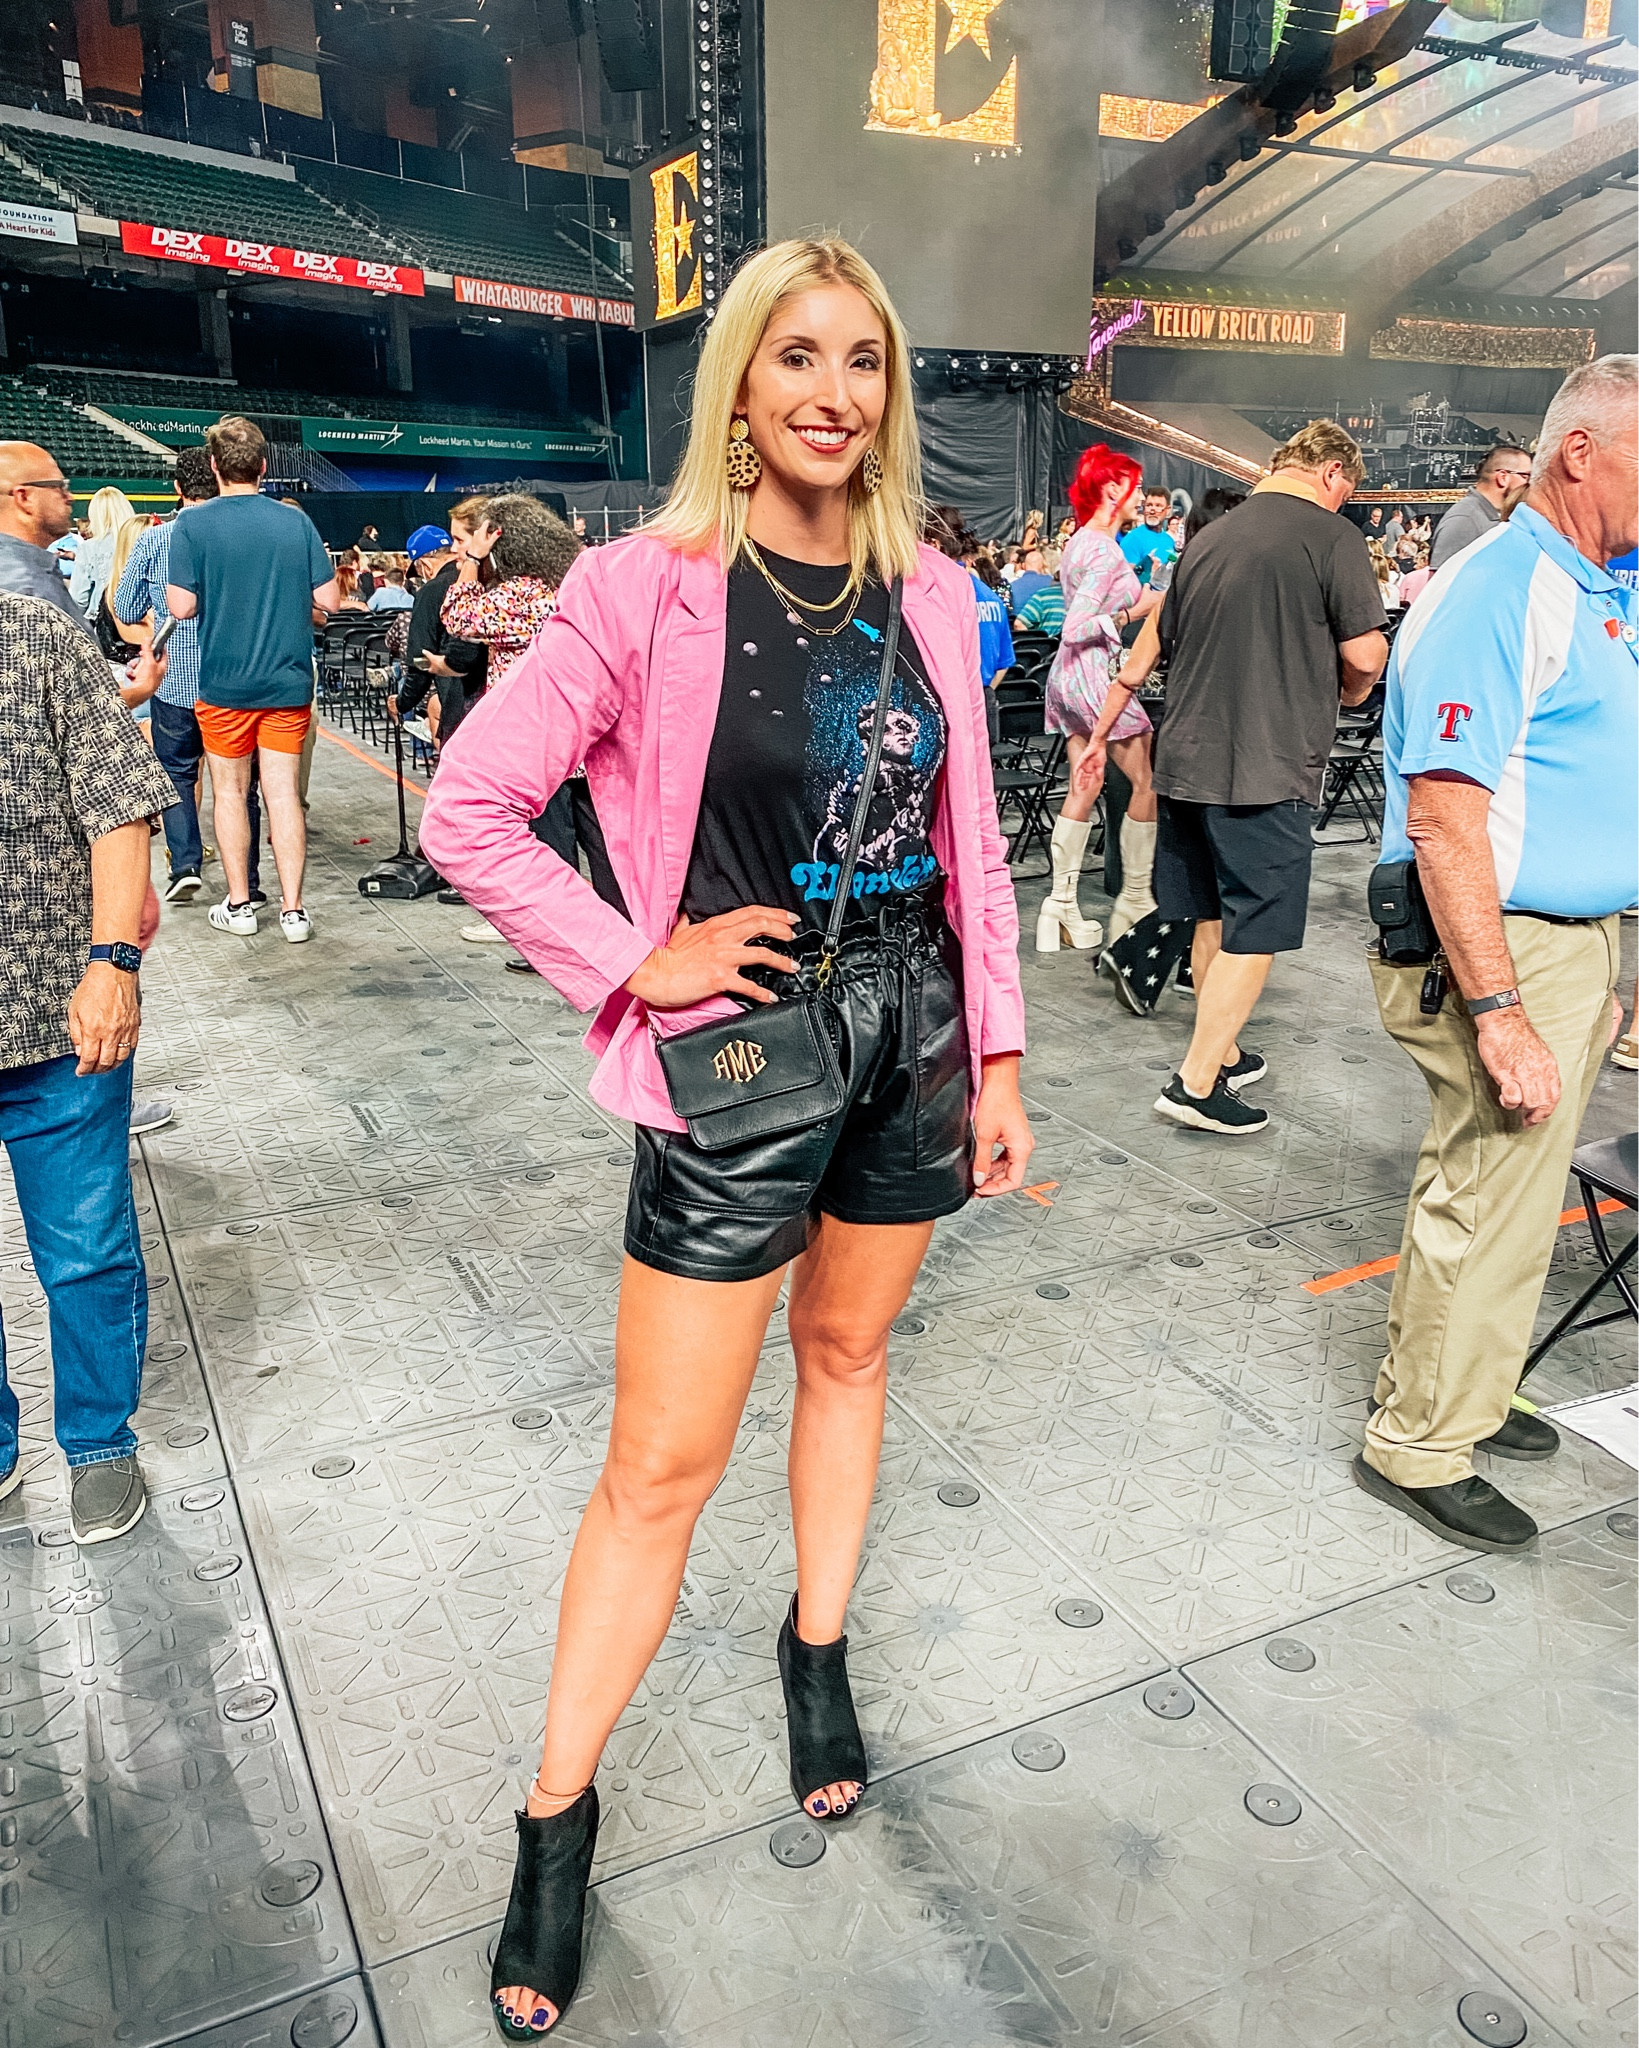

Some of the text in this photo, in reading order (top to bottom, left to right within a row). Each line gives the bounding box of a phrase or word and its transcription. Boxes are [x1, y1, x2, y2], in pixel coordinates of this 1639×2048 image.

[0, 209, 53, 222] OUNDATION
[6, 222, 27, 232] Heart
[28, 225, 39, 234] for
[40, 227, 56, 236] Kids
[151, 227, 204, 252] DEX
[225, 239, 274, 263] DEX
[293, 250, 339, 272] DEX
[356, 260, 398, 282] DEX
[460, 279, 563, 315] WHATABURGER
[1153, 306, 1216, 339] YELLOW
[1218, 310, 1267, 342] BRICK
[1271, 314, 1314, 344] ROAD
[318, 431, 386, 441] LOCKHEED MARTIN
[419, 435, 449, 445] Lockheed
[1437, 702, 1473, 742] T
